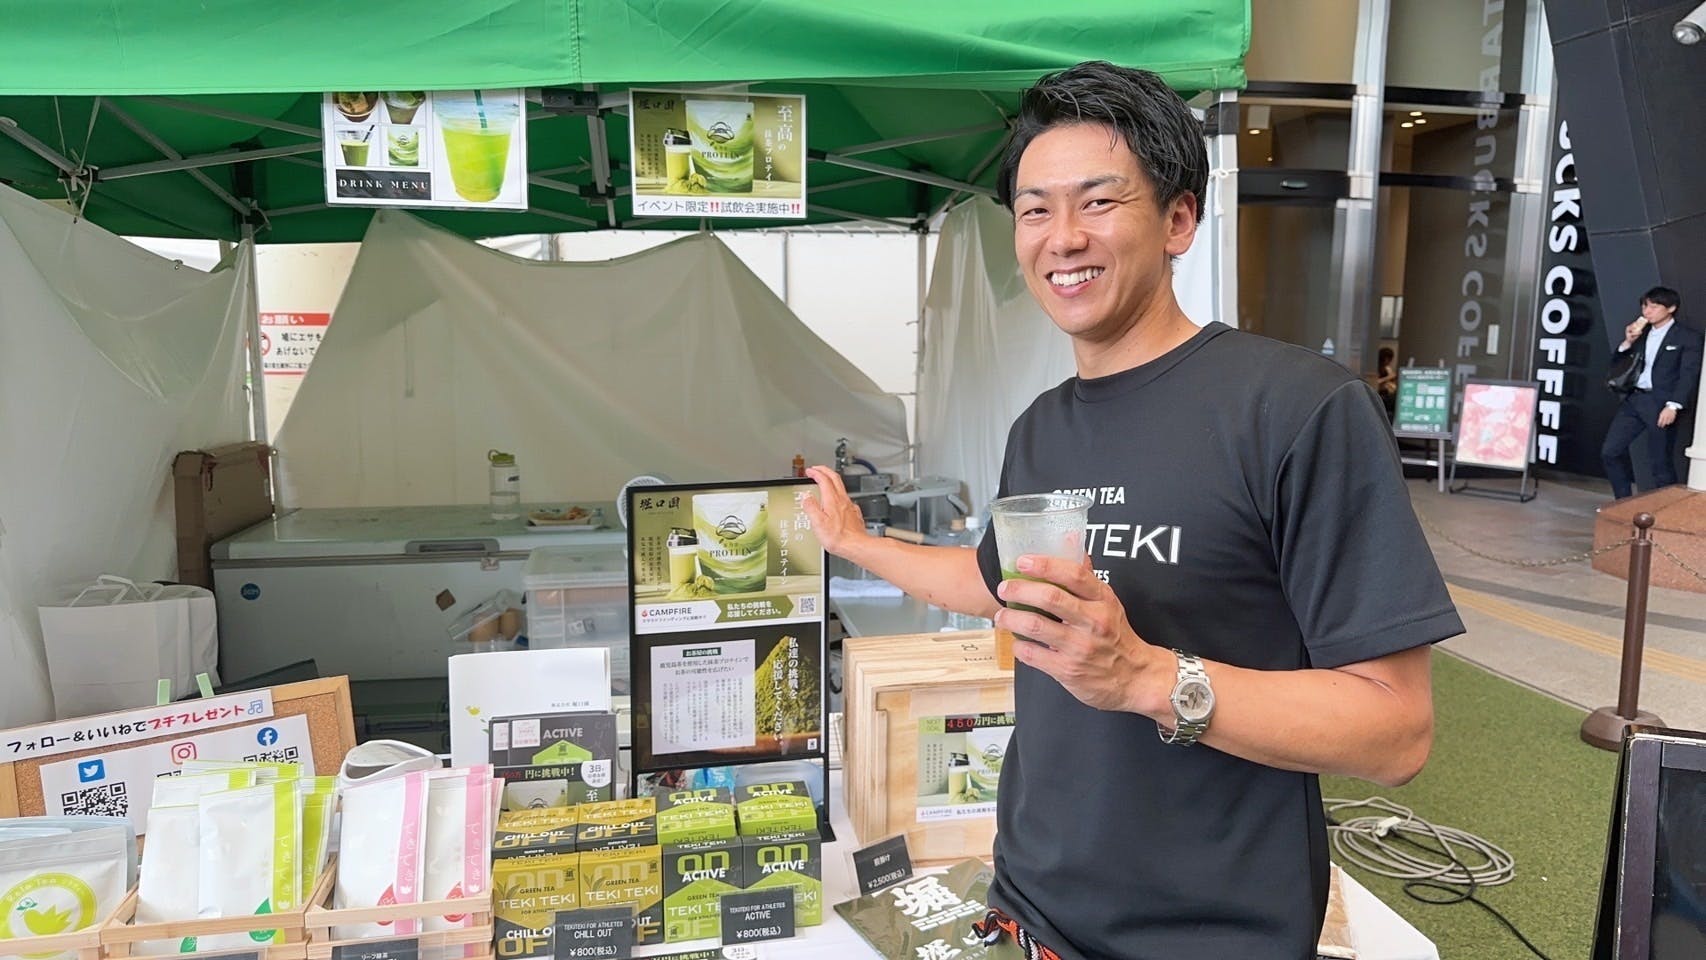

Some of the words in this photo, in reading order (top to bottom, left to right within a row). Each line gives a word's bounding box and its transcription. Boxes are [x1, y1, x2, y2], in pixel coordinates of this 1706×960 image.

[702, 150, 741, 159] PROTEIN
[339, 179, 383, 189] DRINK
[391, 180, 429, 190] MENU
[1537, 265, 1574, 464] COFFEE
[1100, 487, 1125, 505] TEA
[709, 548, 752, 558] PROTEIN
[649, 607, 692, 617] CAMPFIRE
[543, 727, 584, 739] ACTIVE
[752, 789, 792, 798] ACTIVE
[673, 795, 714, 806] ACTIVE
[587, 824, 619, 833] CHILL
[622, 821, 646, 829] OUT
[504, 833, 540, 841] CHILL
[762, 859, 805, 874] ACTIVE
[682, 867, 726, 883] ACTIVE
[585, 890, 620, 901] TEKI
[624, 885, 659, 898] TEKI
[499, 897, 536, 909] TEKI
[539, 893, 576, 906] TEKI
[668, 904, 702, 917] TEKI
[750, 903, 761, 912] FOR
[744, 910, 771, 921] ACTIVE
[586, 922, 597, 930] FOR
[506, 929, 540, 939] CHILL
[542, 926, 556, 937] O
[573, 929, 595, 939] CHILL
[597, 928, 612, 937] OUT
